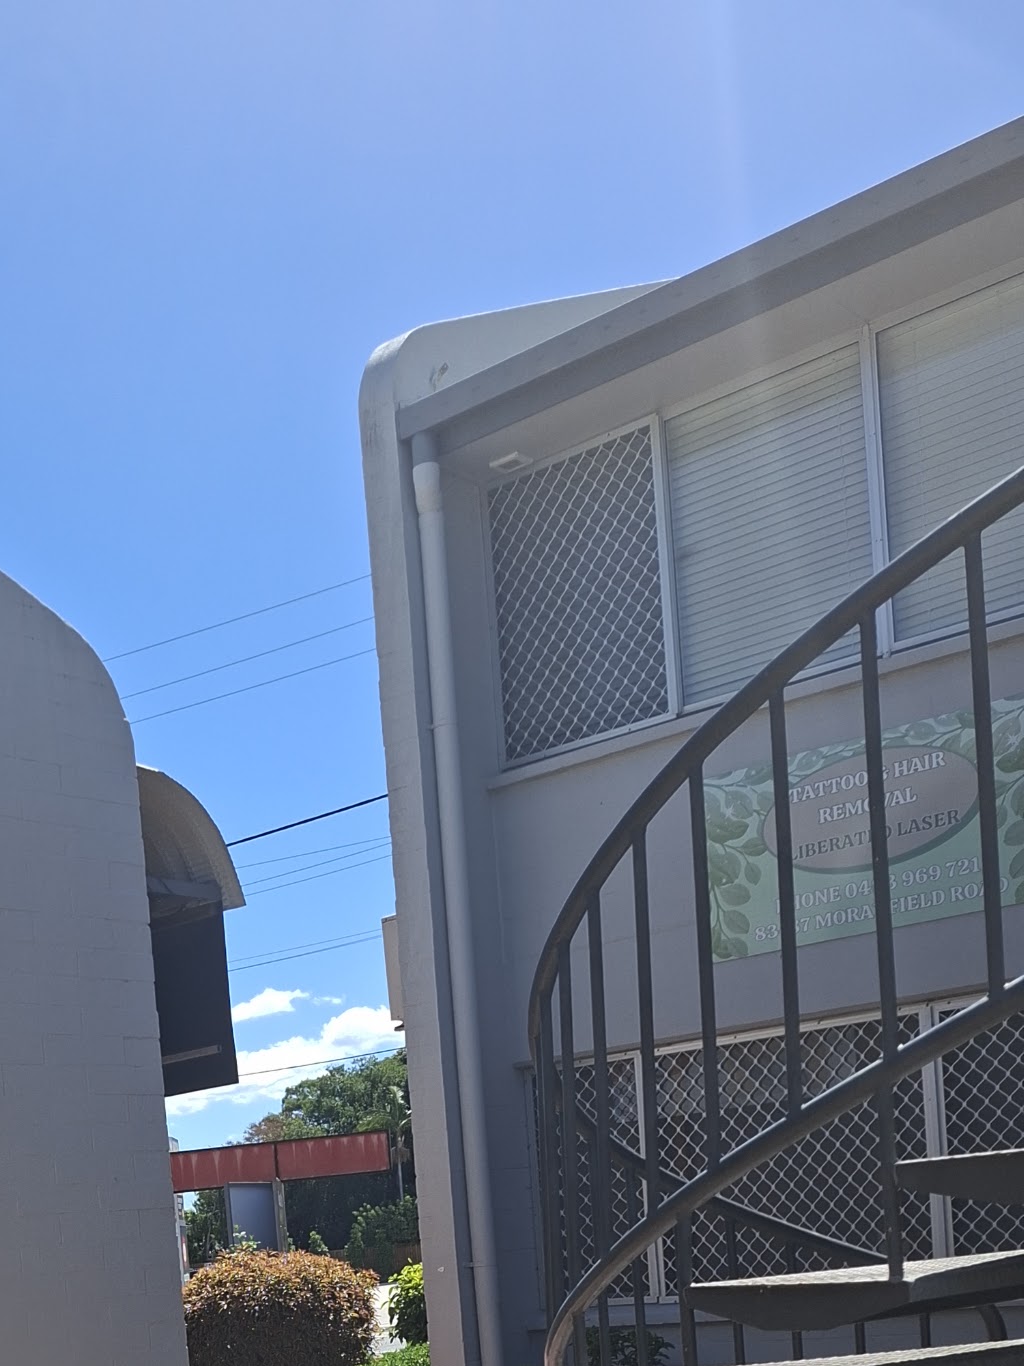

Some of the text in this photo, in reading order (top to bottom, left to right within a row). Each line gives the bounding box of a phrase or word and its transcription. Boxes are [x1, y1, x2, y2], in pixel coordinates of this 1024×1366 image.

[789, 771, 870, 804] TATTOO
[893, 750, 946, 778] HAIR
[896, 808, 961, 837] LASER
[845, 870, 898, 900] 043
[902, 864, 942, 888] 969
[945, 856, 980, 879] 721
[814, 889, 945, 930] MORAFIELD
